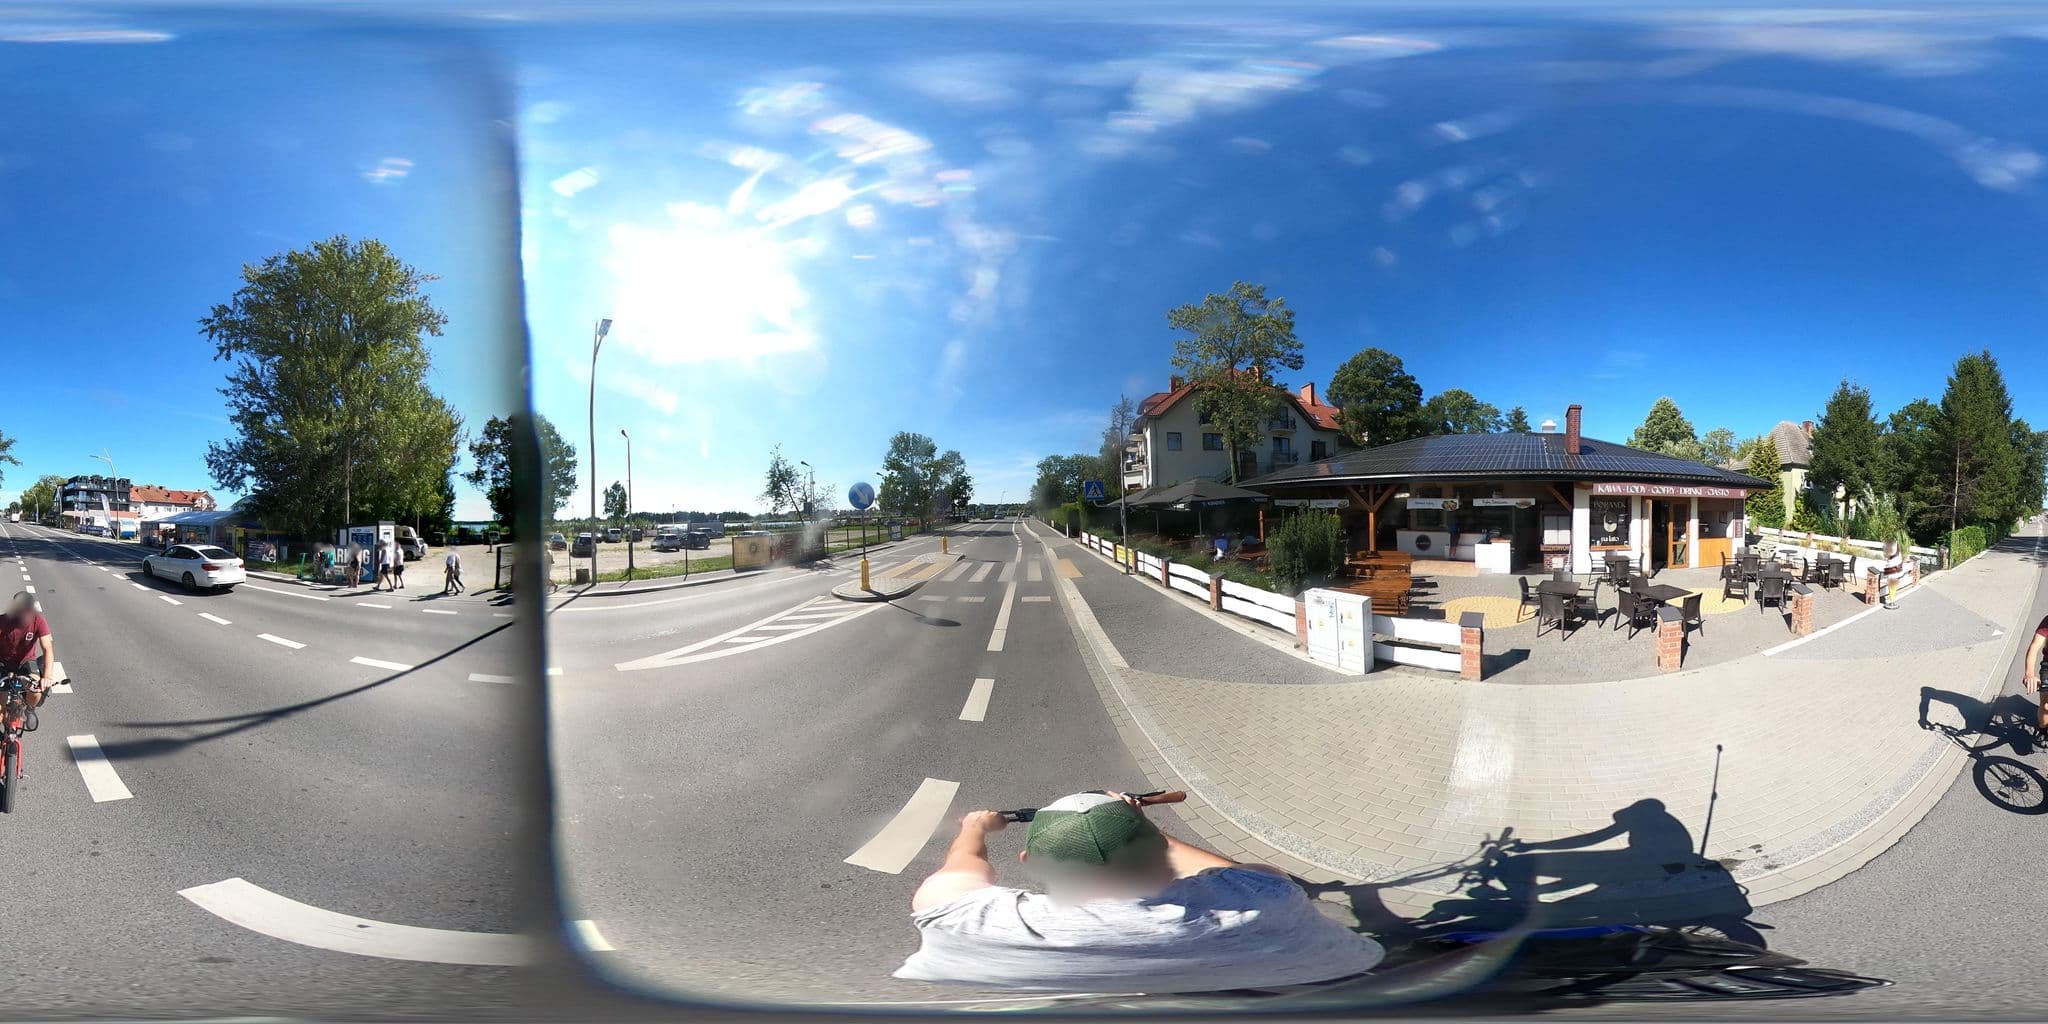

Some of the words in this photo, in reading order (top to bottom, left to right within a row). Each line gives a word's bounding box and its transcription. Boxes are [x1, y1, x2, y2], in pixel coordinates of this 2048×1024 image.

[1598, 485, 1622, 493] KAWA
[1626, 485, 1646, 493] LODY
[1651, 486, 1675, 495] GOFRY
